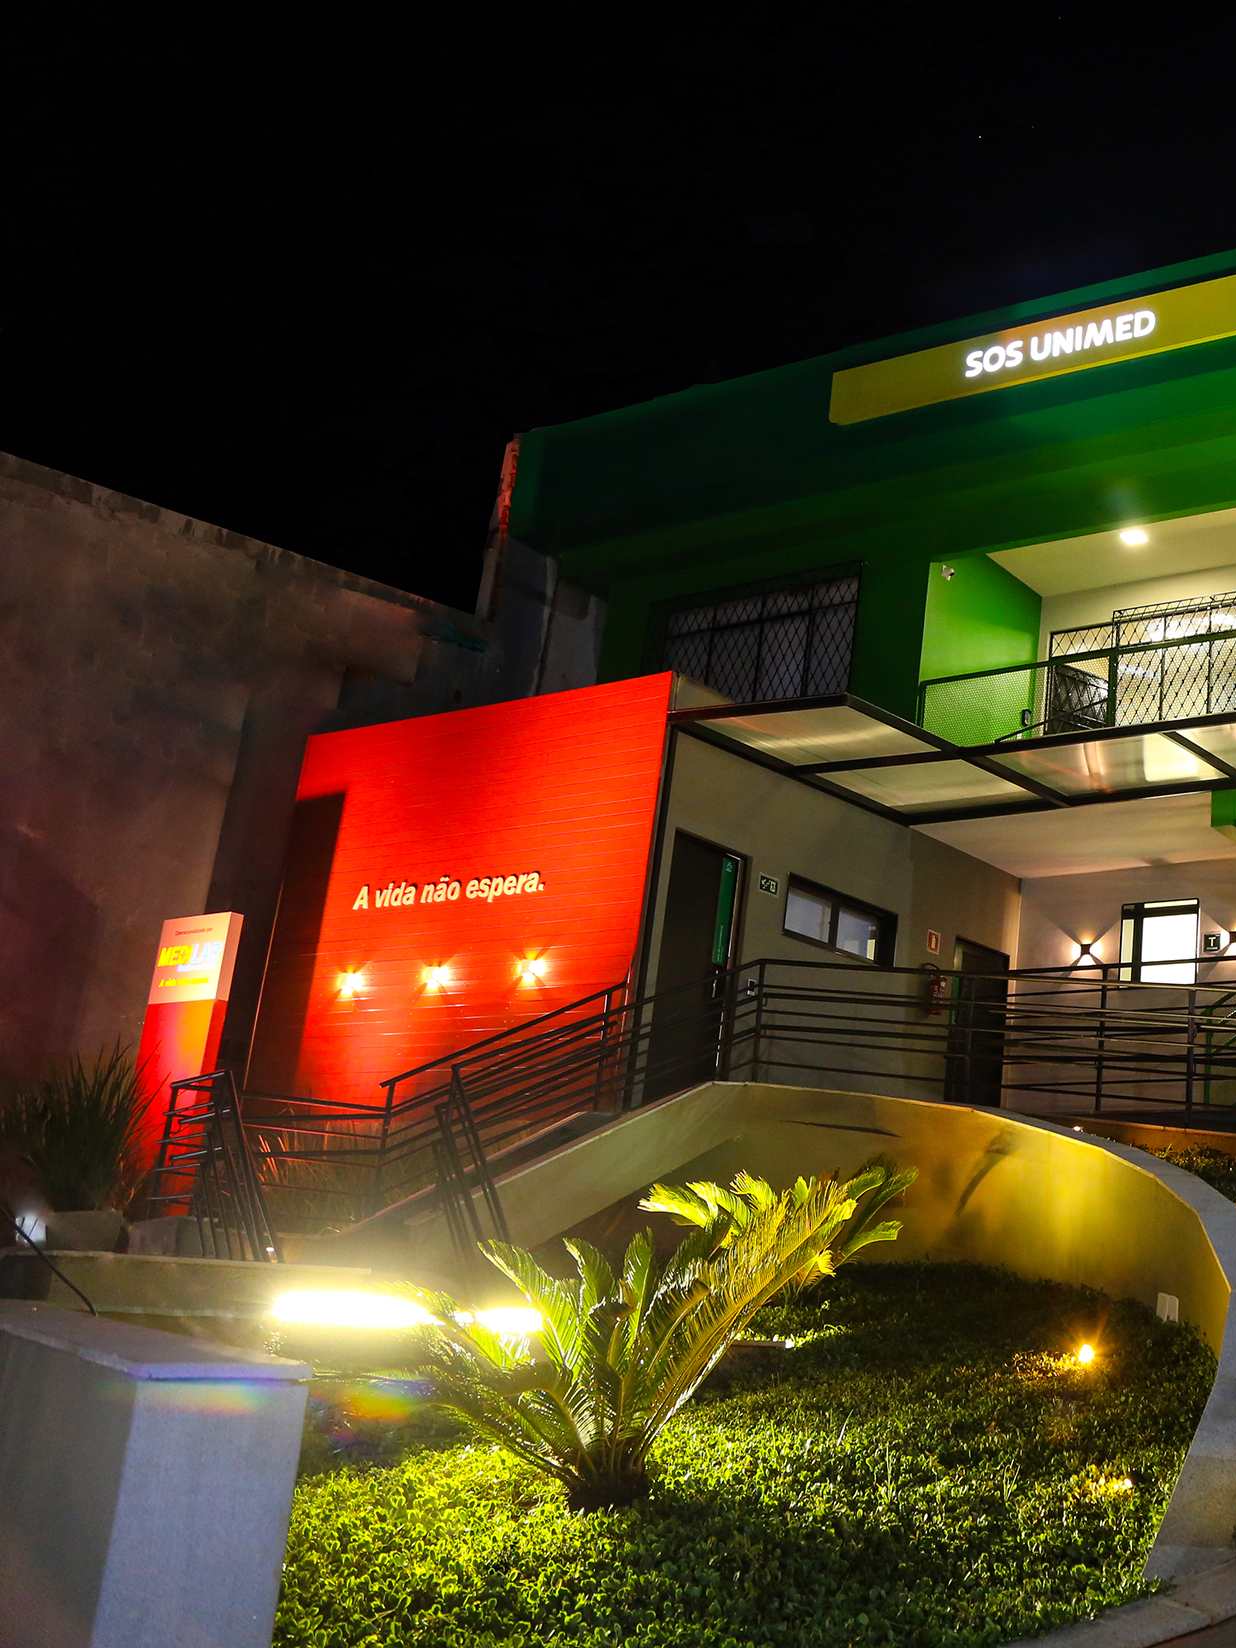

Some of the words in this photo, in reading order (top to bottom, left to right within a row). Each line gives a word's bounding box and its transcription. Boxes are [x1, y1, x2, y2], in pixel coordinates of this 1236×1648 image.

[964, 339, 1024, 378] SOS
[1029, 309, 1157, 362] UNIMED
[352, 885, 370, 910] A
[375, 881, 418, 908] vida
[420, 876, 462, 904] não
[465, 871, 545, 902] espera.
[157, 941, 222, 967] MEDILAR
